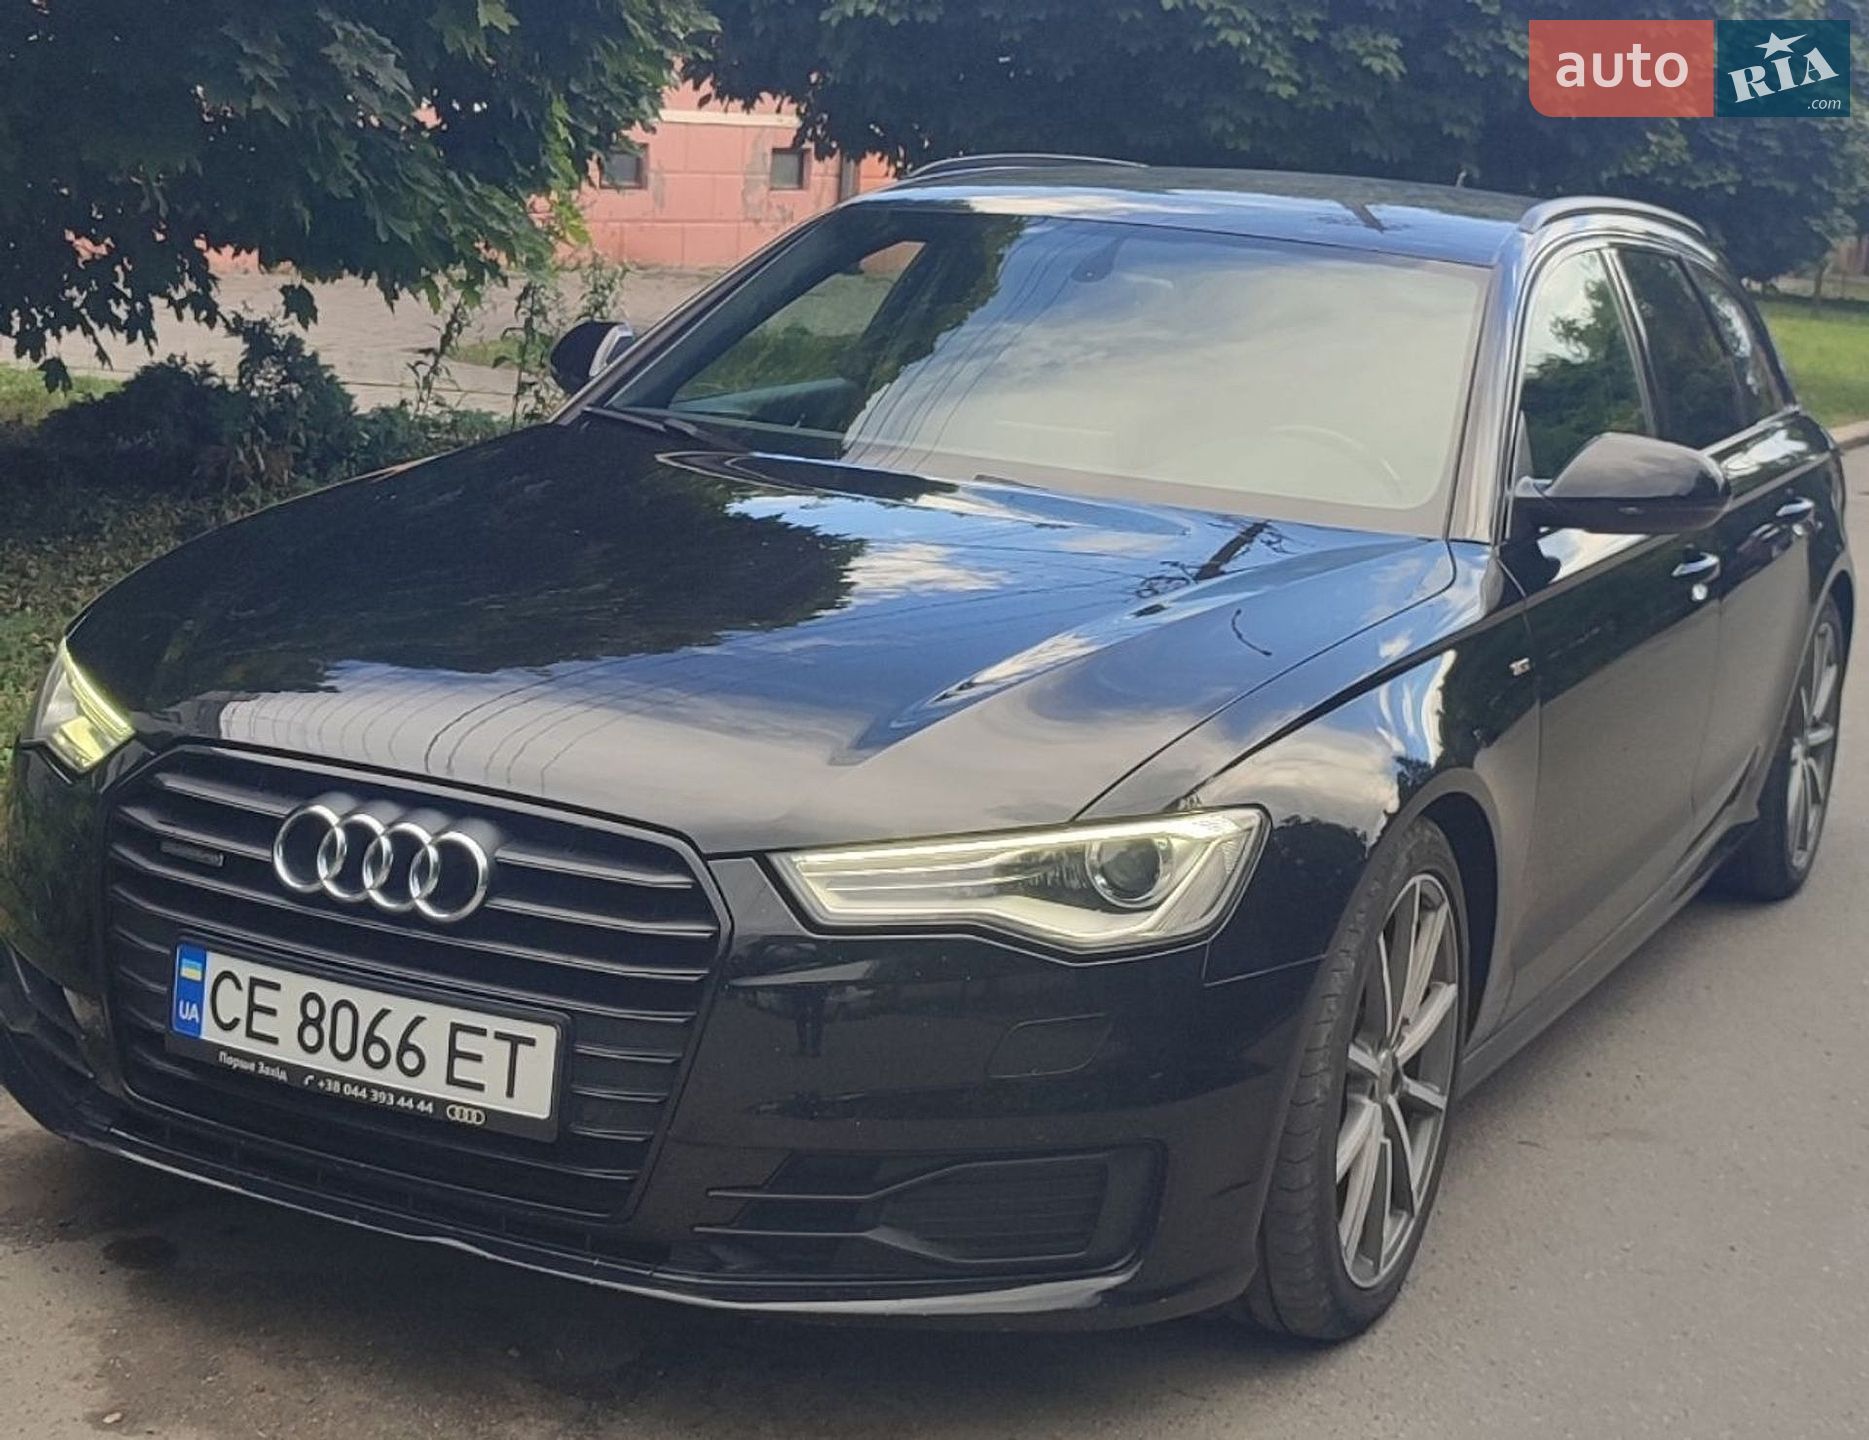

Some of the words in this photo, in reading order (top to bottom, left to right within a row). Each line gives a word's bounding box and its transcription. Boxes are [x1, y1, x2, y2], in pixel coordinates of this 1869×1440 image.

[178, 1000, 200, 1023] UA
[210, 970, 282, 1046] CE
[297, 991, 428, 1078] 8066
[445, 1021, 537, 1099] ET
[317, 1078, 340, 1094] +38
[343, 1084, 368, 1100] 044
[371, 1089, 395, 1106] 393
[396, 1097, 415, 1110] 44
[416, 1100, 434, 1114] 44
